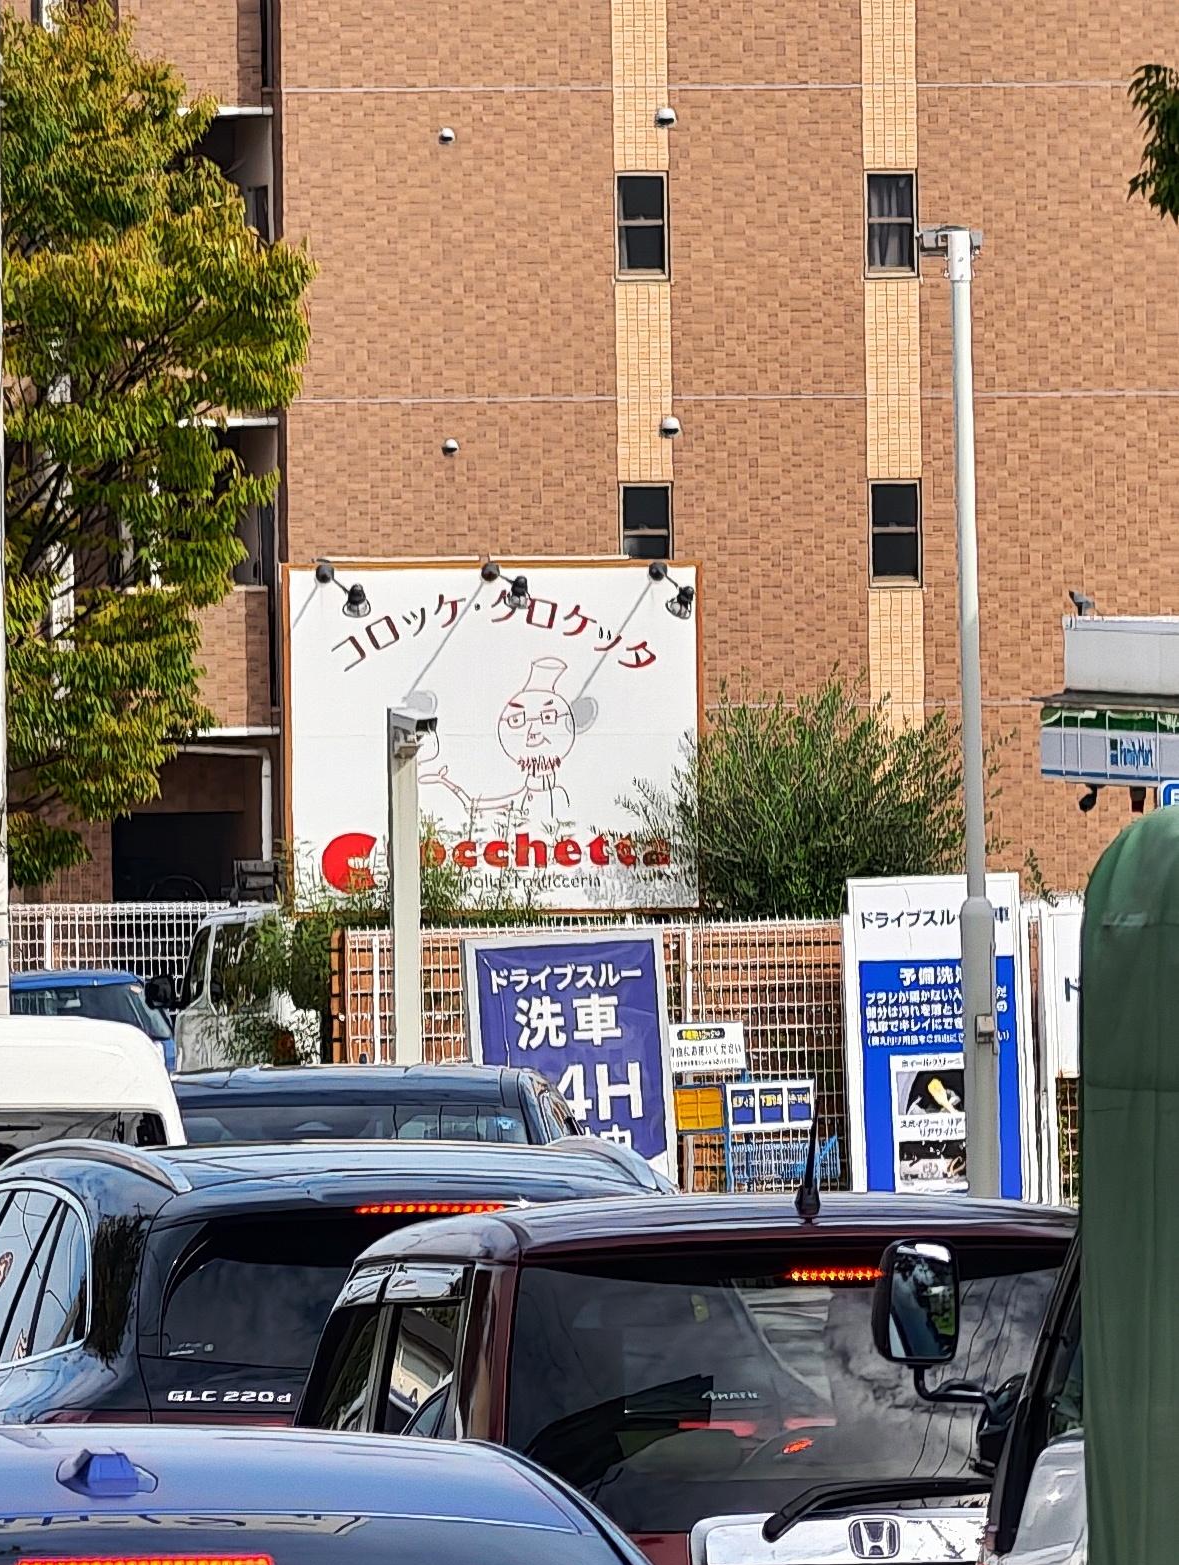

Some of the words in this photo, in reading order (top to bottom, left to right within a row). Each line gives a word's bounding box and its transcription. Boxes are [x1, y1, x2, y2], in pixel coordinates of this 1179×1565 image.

[322, 832, 672, 894] Cocchetta
[491, 962, 642, 995] ドライブスルー
[514, 993, 622, 1051] 洗車
[167, 1390, 218, 1402] GLC
